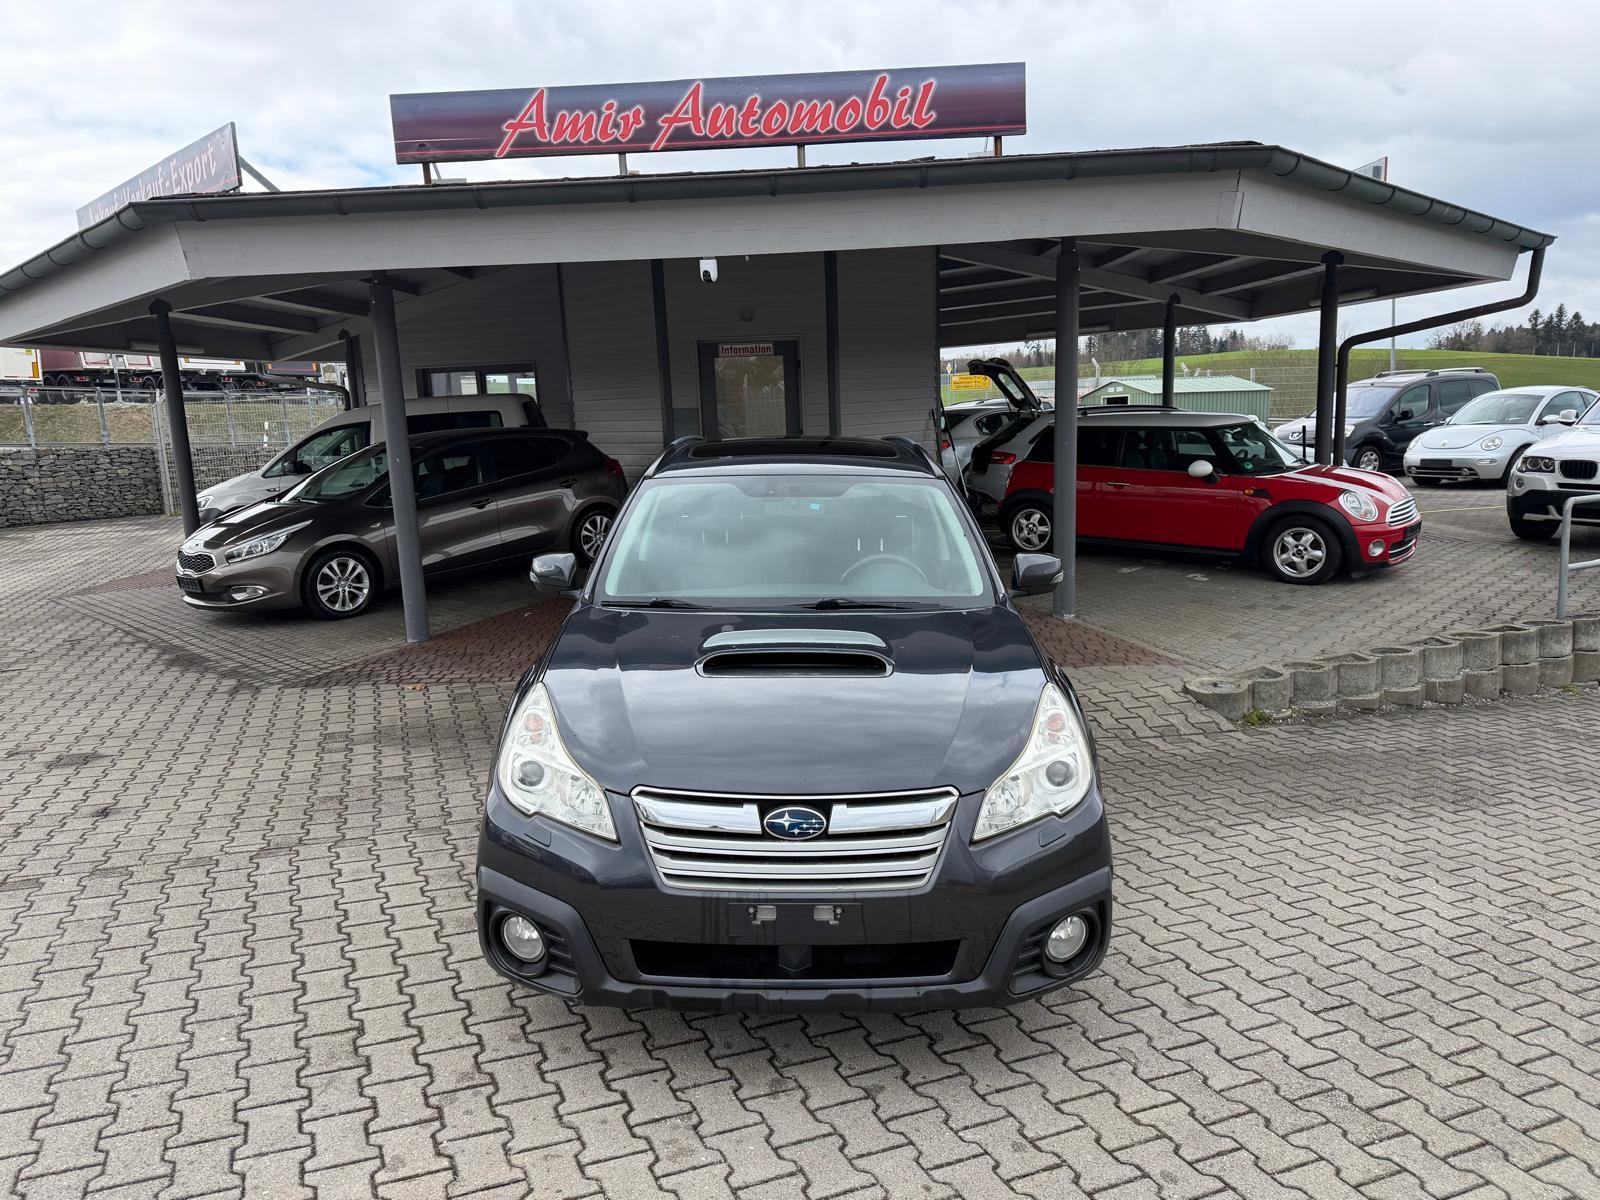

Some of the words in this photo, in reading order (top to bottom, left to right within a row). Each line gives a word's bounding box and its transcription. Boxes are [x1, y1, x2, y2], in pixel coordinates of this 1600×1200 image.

[496, 86, 645, 158] Amir
[651, 73, 936, 151] Automobil
[721, 344, 772, 355] Information
